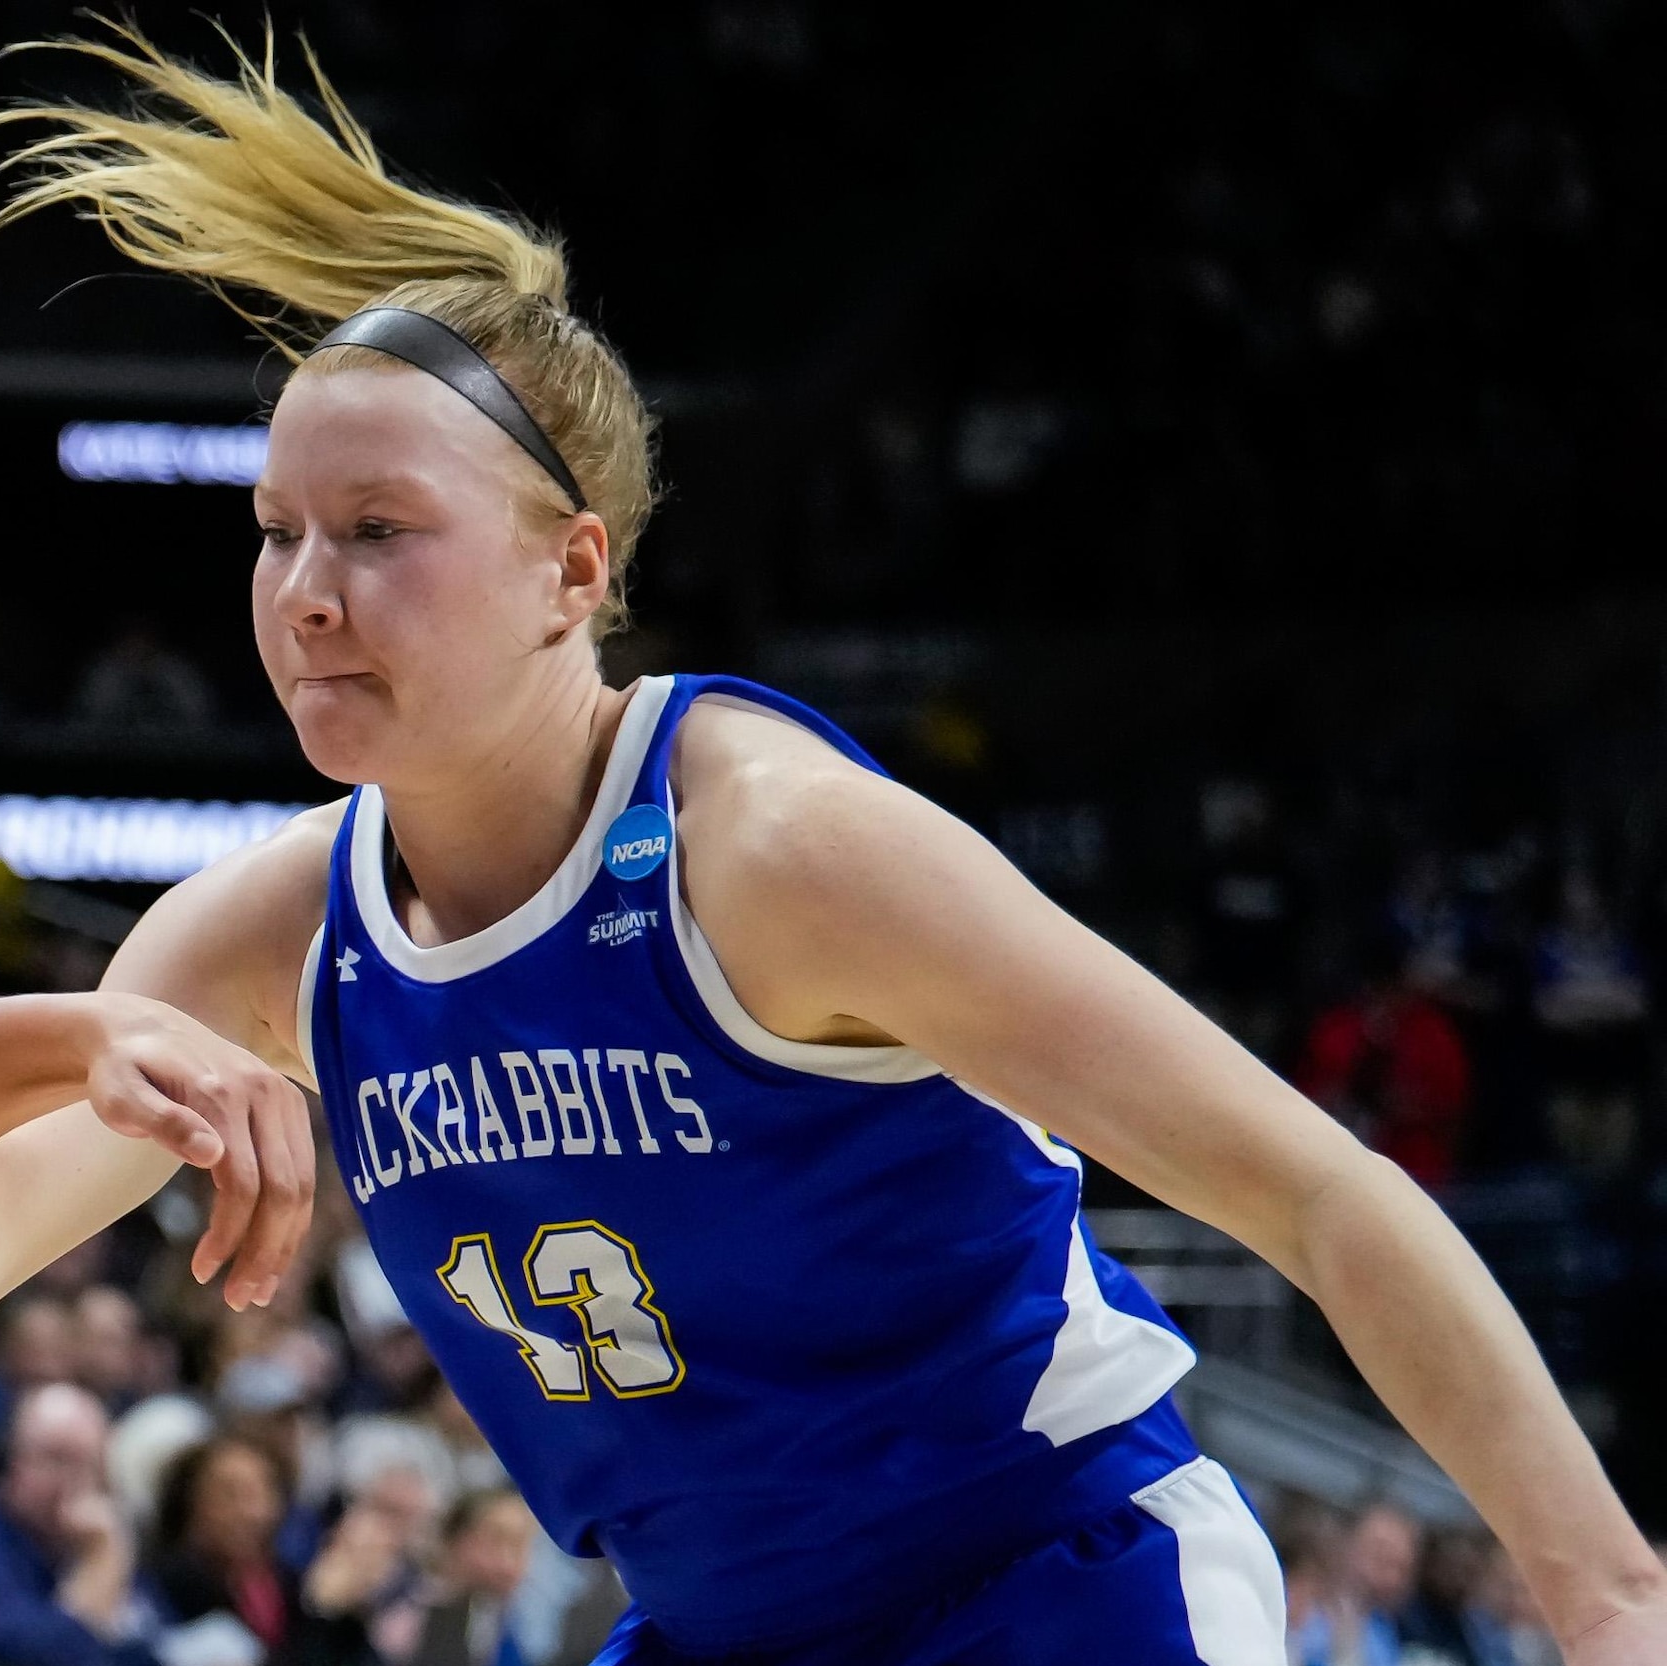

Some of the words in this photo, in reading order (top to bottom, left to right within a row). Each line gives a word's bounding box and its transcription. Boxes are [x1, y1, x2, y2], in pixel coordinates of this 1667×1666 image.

[612, 836, 665, 865] NCAA
[589, 910, 658, 943] SUMMIT
[596, 911, 615, 922] THE
[353, 1048, 714, 1204] CKRABBITS
[436, 1219, 686, 1402] 13
